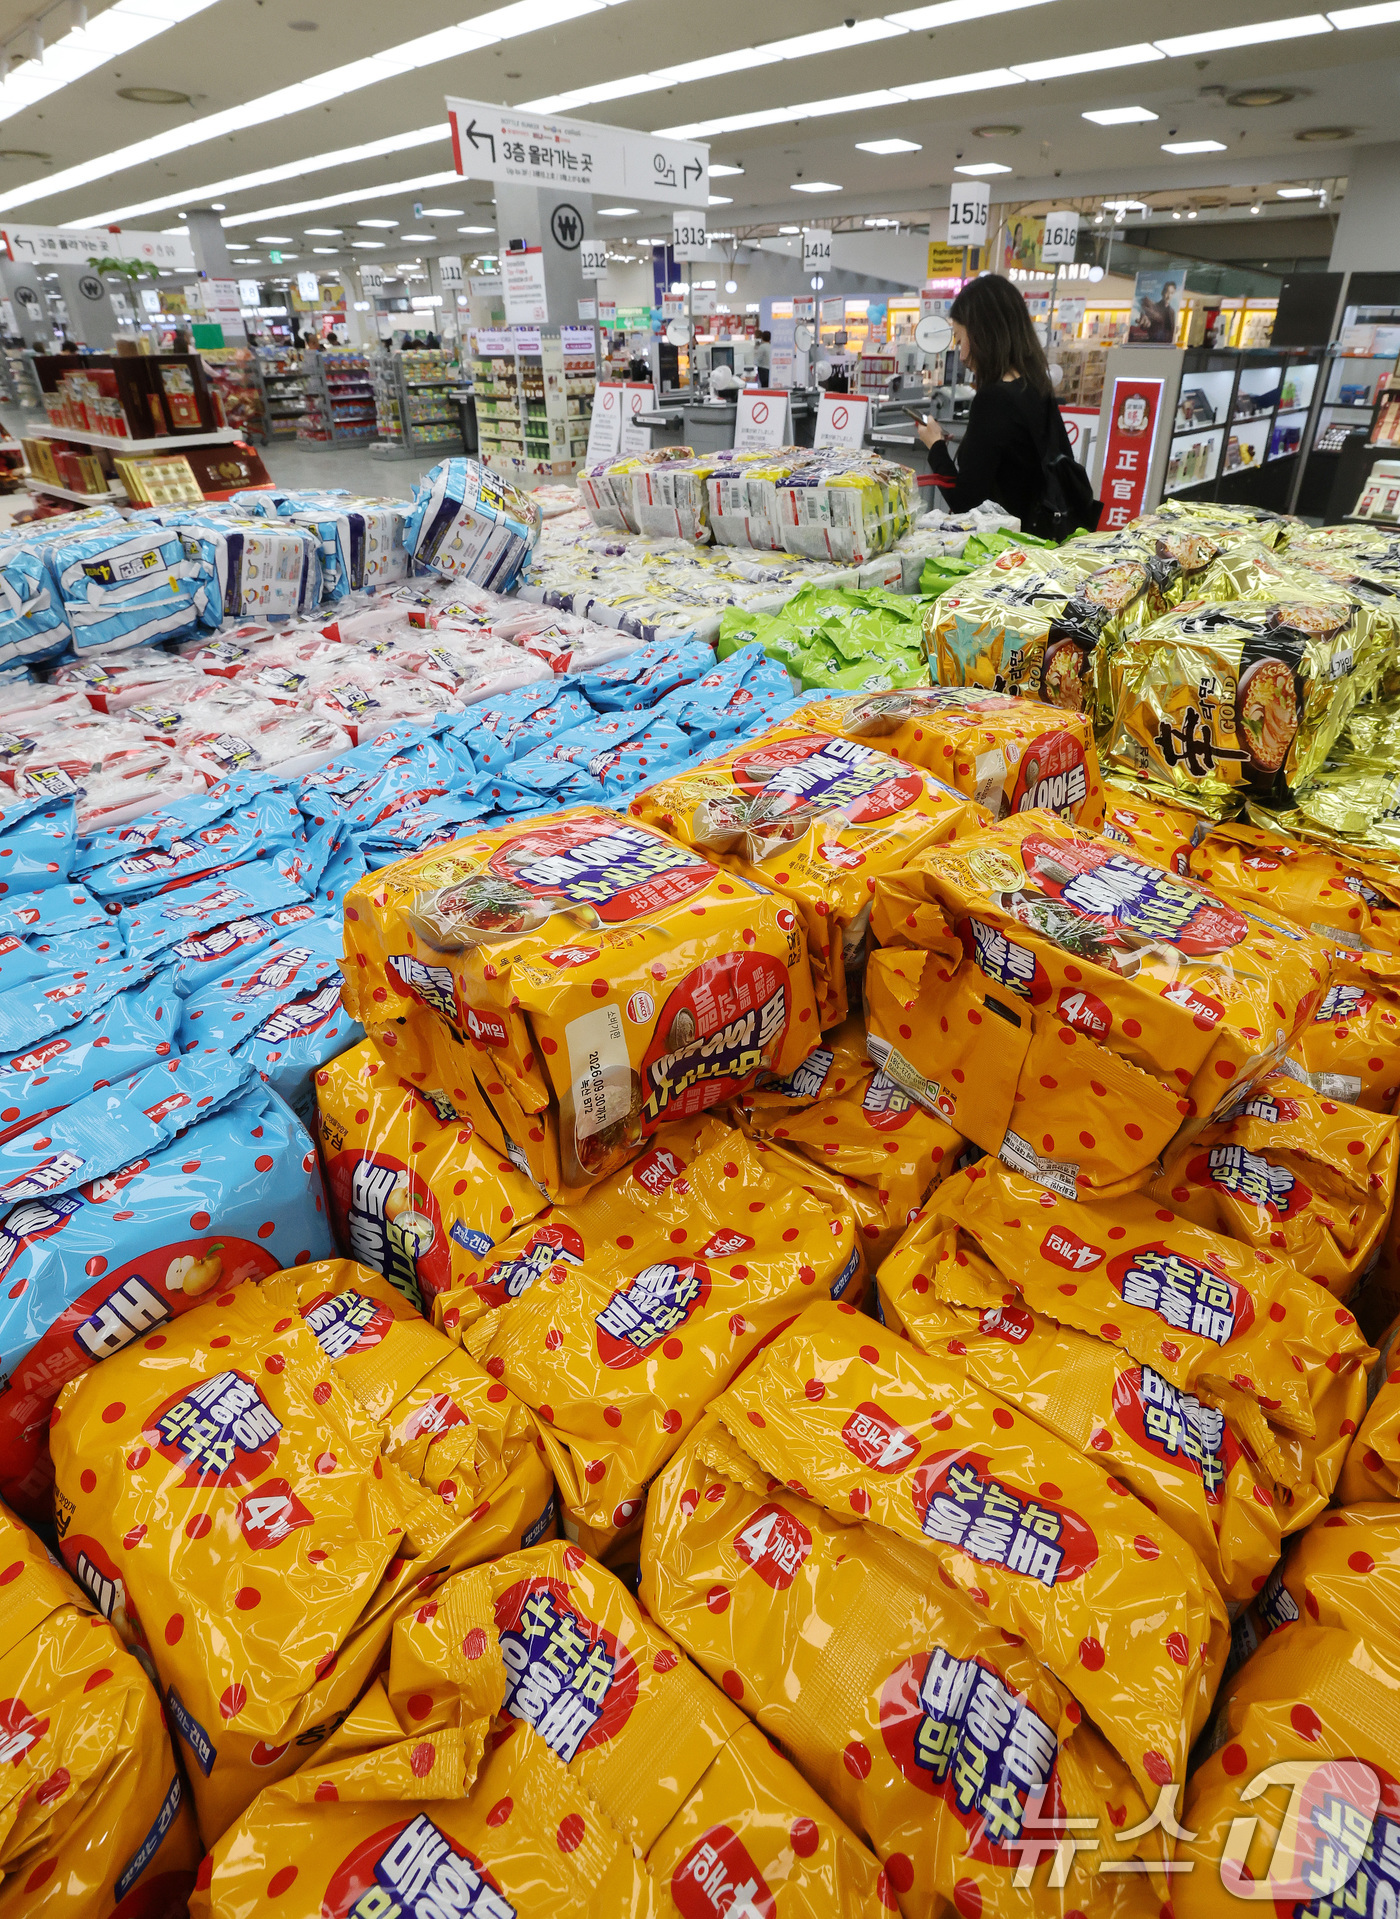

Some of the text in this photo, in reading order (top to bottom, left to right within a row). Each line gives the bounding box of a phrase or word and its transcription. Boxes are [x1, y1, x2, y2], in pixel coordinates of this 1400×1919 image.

[503, 142, 593, 173] 3층 올라가는 곳
[1029, 645, 1044, 692] GOLD
[1199, 676, 1217, 720] 라면
[1219, 675, 1237, 734] GOLD
[766, 738, 874, 795] 배홍동
[1154, 706, 1251, 778] 辛
[519, 826, 665, 886] 배홍동
[568, 846, 689, 903] 막국수
[970, 916, 1036, 979] 배홍동
[255, 985, 342, 1044] 배홍동
[467, 1010, 505, 1039] 4개입
[607, 1011, 621, 1040] 소비기한
[637, 996, 649, 1018] HACCP
[689, 982, 718, 1034] 메밀
[718, 984, 736, 1022] 고소
[1060, 992, 1107, 1031] 4개입
[1165, 987, 1219, 1022] 4개입
[650, 985, 786, 1084] 배홍동
[580, 1079, 593, 1115] 녹산 B72
[588, 1050, 607, 1125] 2026.09.30까지
[323, 1121, 344, 1152] 농심
[638, 1149, 681, 1187] 4개입
[456, 1225, 491, 1256] 맛있는 건면
[1047, 1231, 1100, 1269] 4개입
[1122, 1271, 1236, 1346] 배홍동
[1134, 1252, 1232, 1309] 막국수
[628, 1276, 699, 1348] 막국수
[24, 1346, 79, 1391] 시원
[158, 1401, 235, 1472] 막국수
[187, 1372, 282, 1450] 배홍동
[855, 1414, 915, 1468] 4개입
[948, 1465, 1061, 1542] 막국수
[738, 1511, 800, 1575] 4개입
[922, 1498, 1064, 1587] 배홍동
[520, 1595, 614, 1705] 막국수
[189, 1723, 211, 1764] 건면
[920, 1650, 1057, 1798] 배홍동
[917, 1716, 1023, 1843] 막국수
